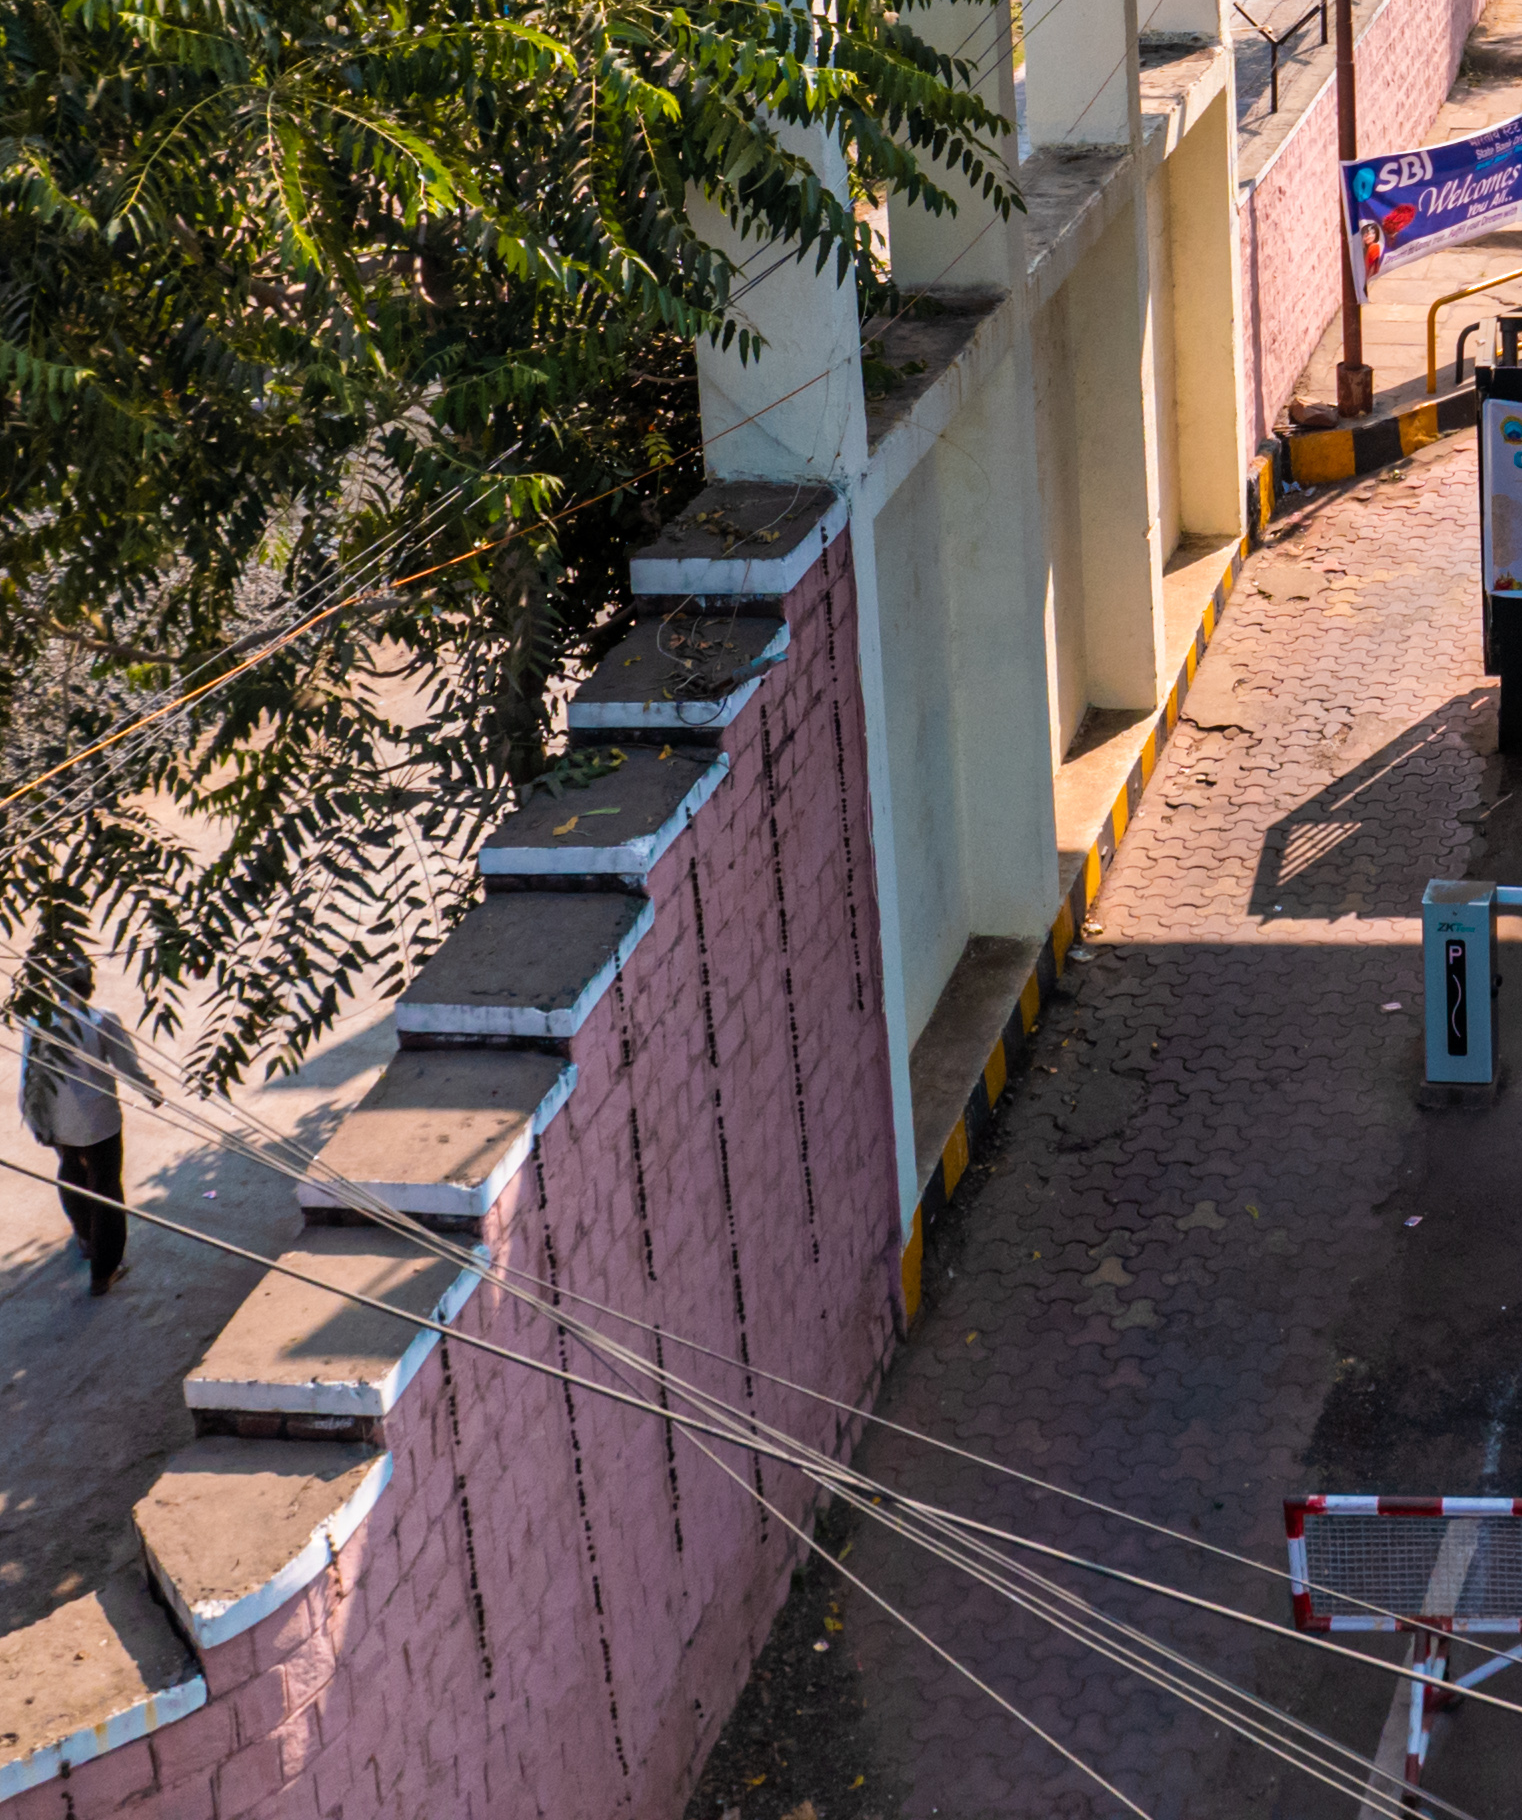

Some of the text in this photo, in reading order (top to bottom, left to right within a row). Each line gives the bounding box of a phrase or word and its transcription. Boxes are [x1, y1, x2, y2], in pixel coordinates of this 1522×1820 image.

[1375, 150, 1434, 193] SBI
[1418, 163, 1522, 217] Welcomes
[1467, 201, 1488, 218] You
[1449, 945, 1463, 965] P
